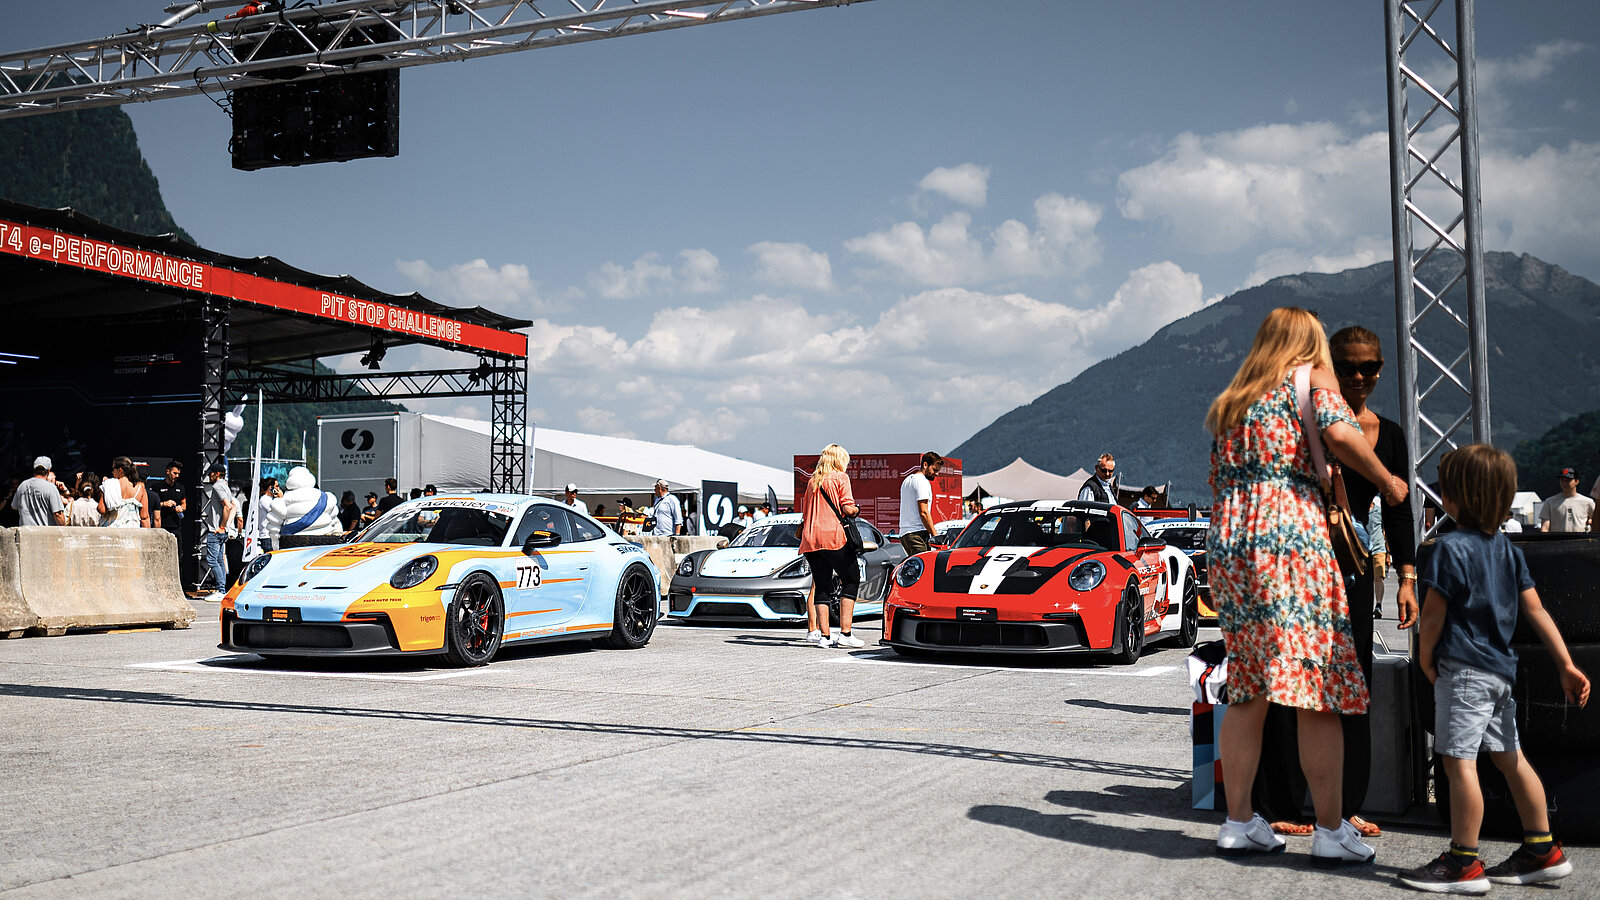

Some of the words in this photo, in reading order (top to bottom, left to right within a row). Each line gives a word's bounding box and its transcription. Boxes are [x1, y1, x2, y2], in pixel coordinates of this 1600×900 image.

[29, 235, 203, 288] e-PERFORMANCE
[321, 294, 346, 318] PIT
[348, 299, 386, 325] STOP
[387, 308, 462, 342] CHALLENGE
[114, 353, 175, 362] PORSCHE
[860, 459, 889, 469] LEGAL
[859, 470, 898, 479] MODELS
[984, 506, 1108, 517] PORSCHE
[993, 554, 1016, 562] 5
[516, 566, 541, 588] 773
[521, 626, 565, 638] PORSCHE
